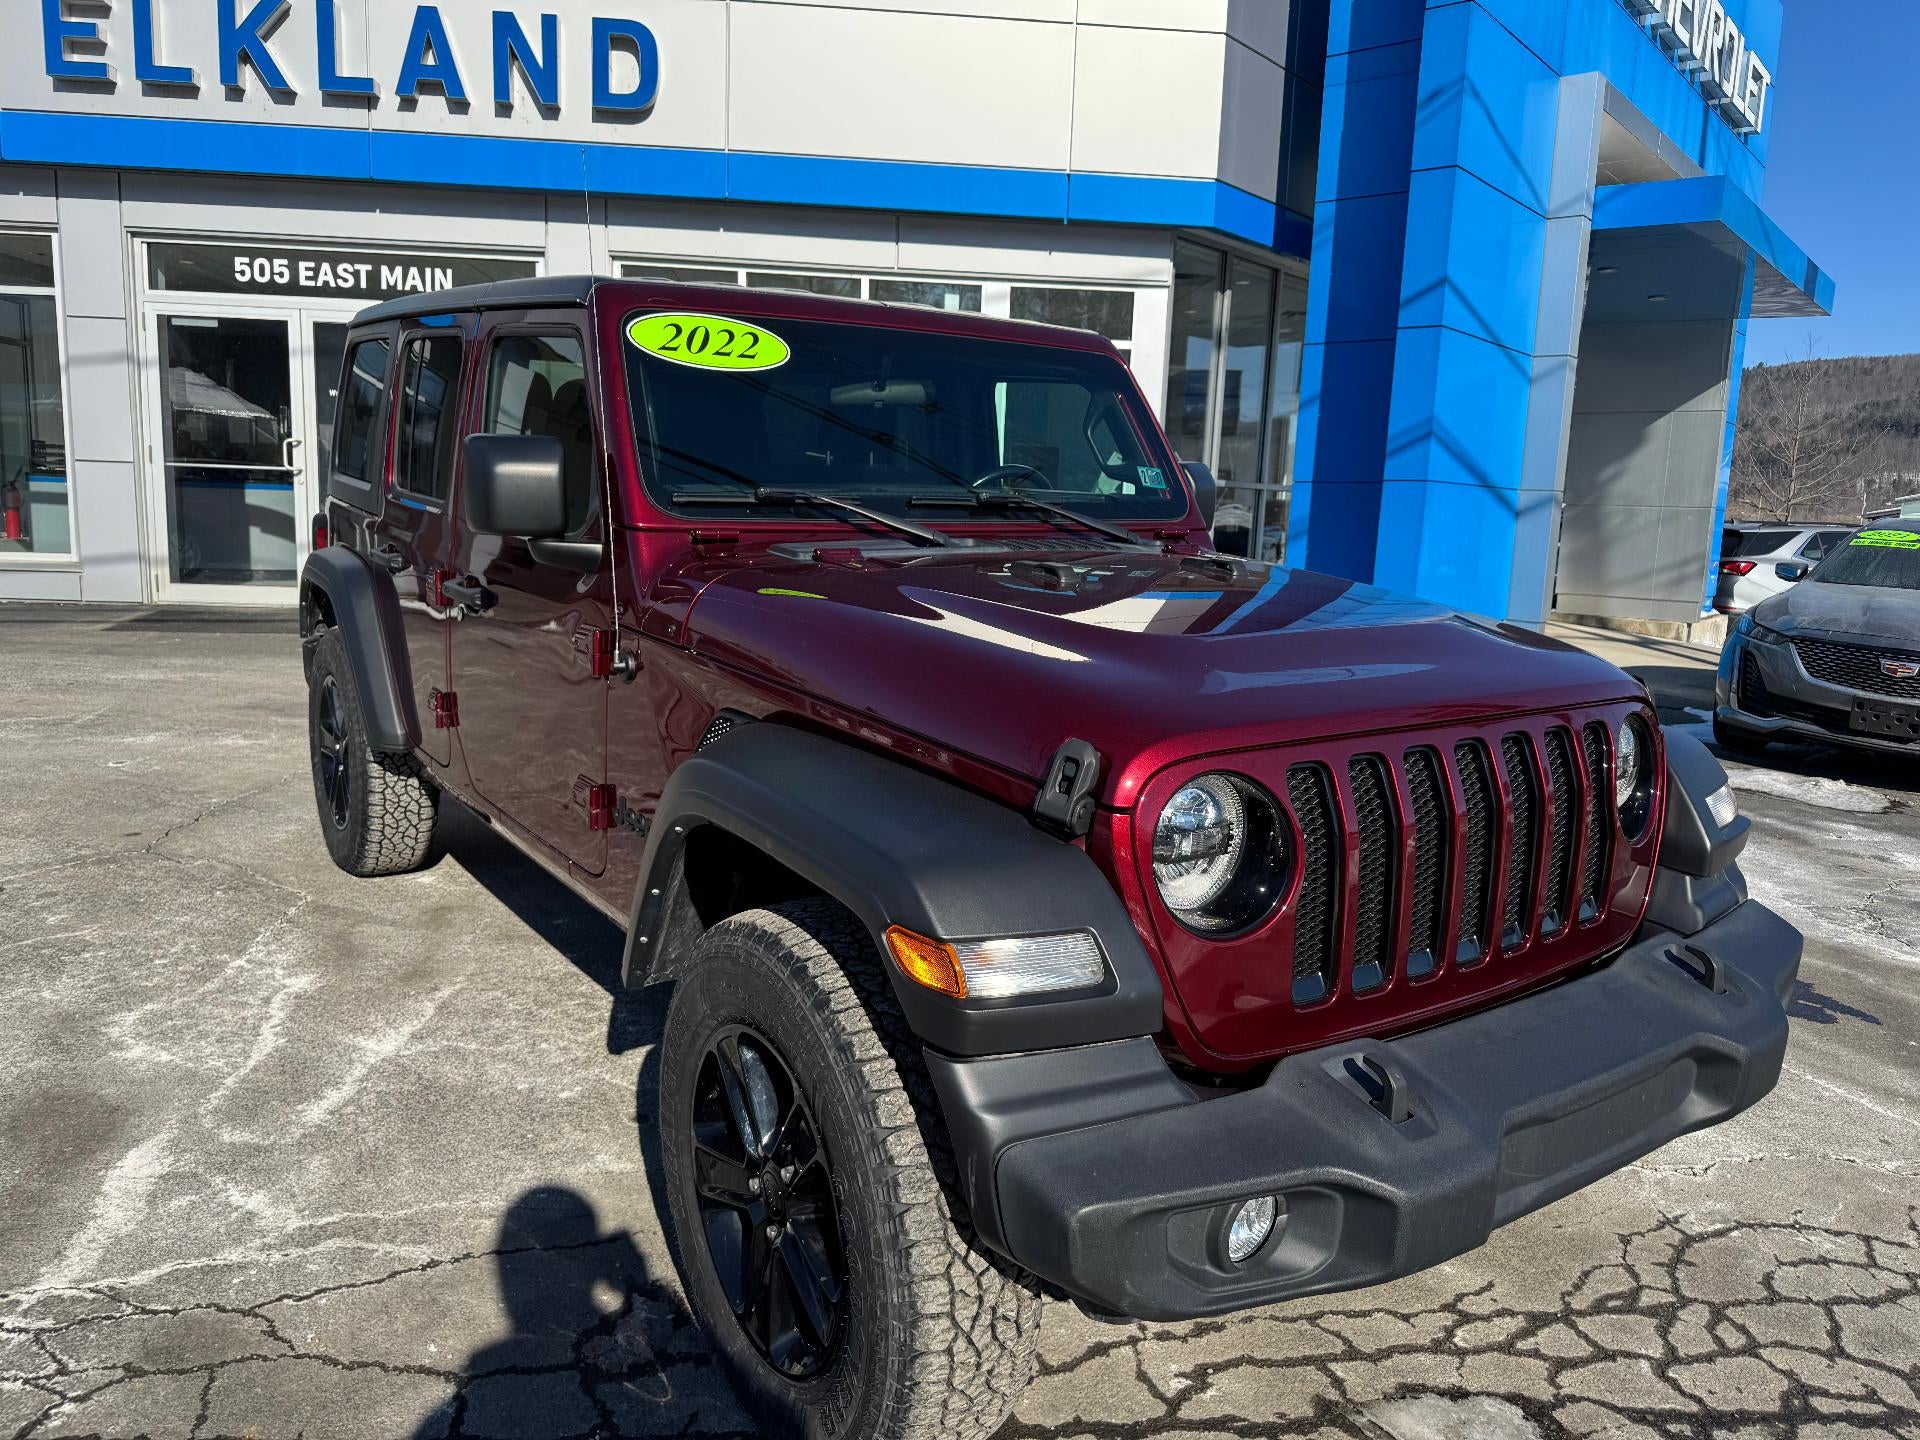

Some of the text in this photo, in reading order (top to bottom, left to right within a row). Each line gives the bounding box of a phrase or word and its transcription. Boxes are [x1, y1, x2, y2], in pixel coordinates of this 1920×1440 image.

[42, 0, 662, 111] ELKLAND
[1649, 0, 1772, 135] EVROLET
[234, 256, 453, 293] 505 EAST MAIN
[657, 322, 760, 360] 2022
